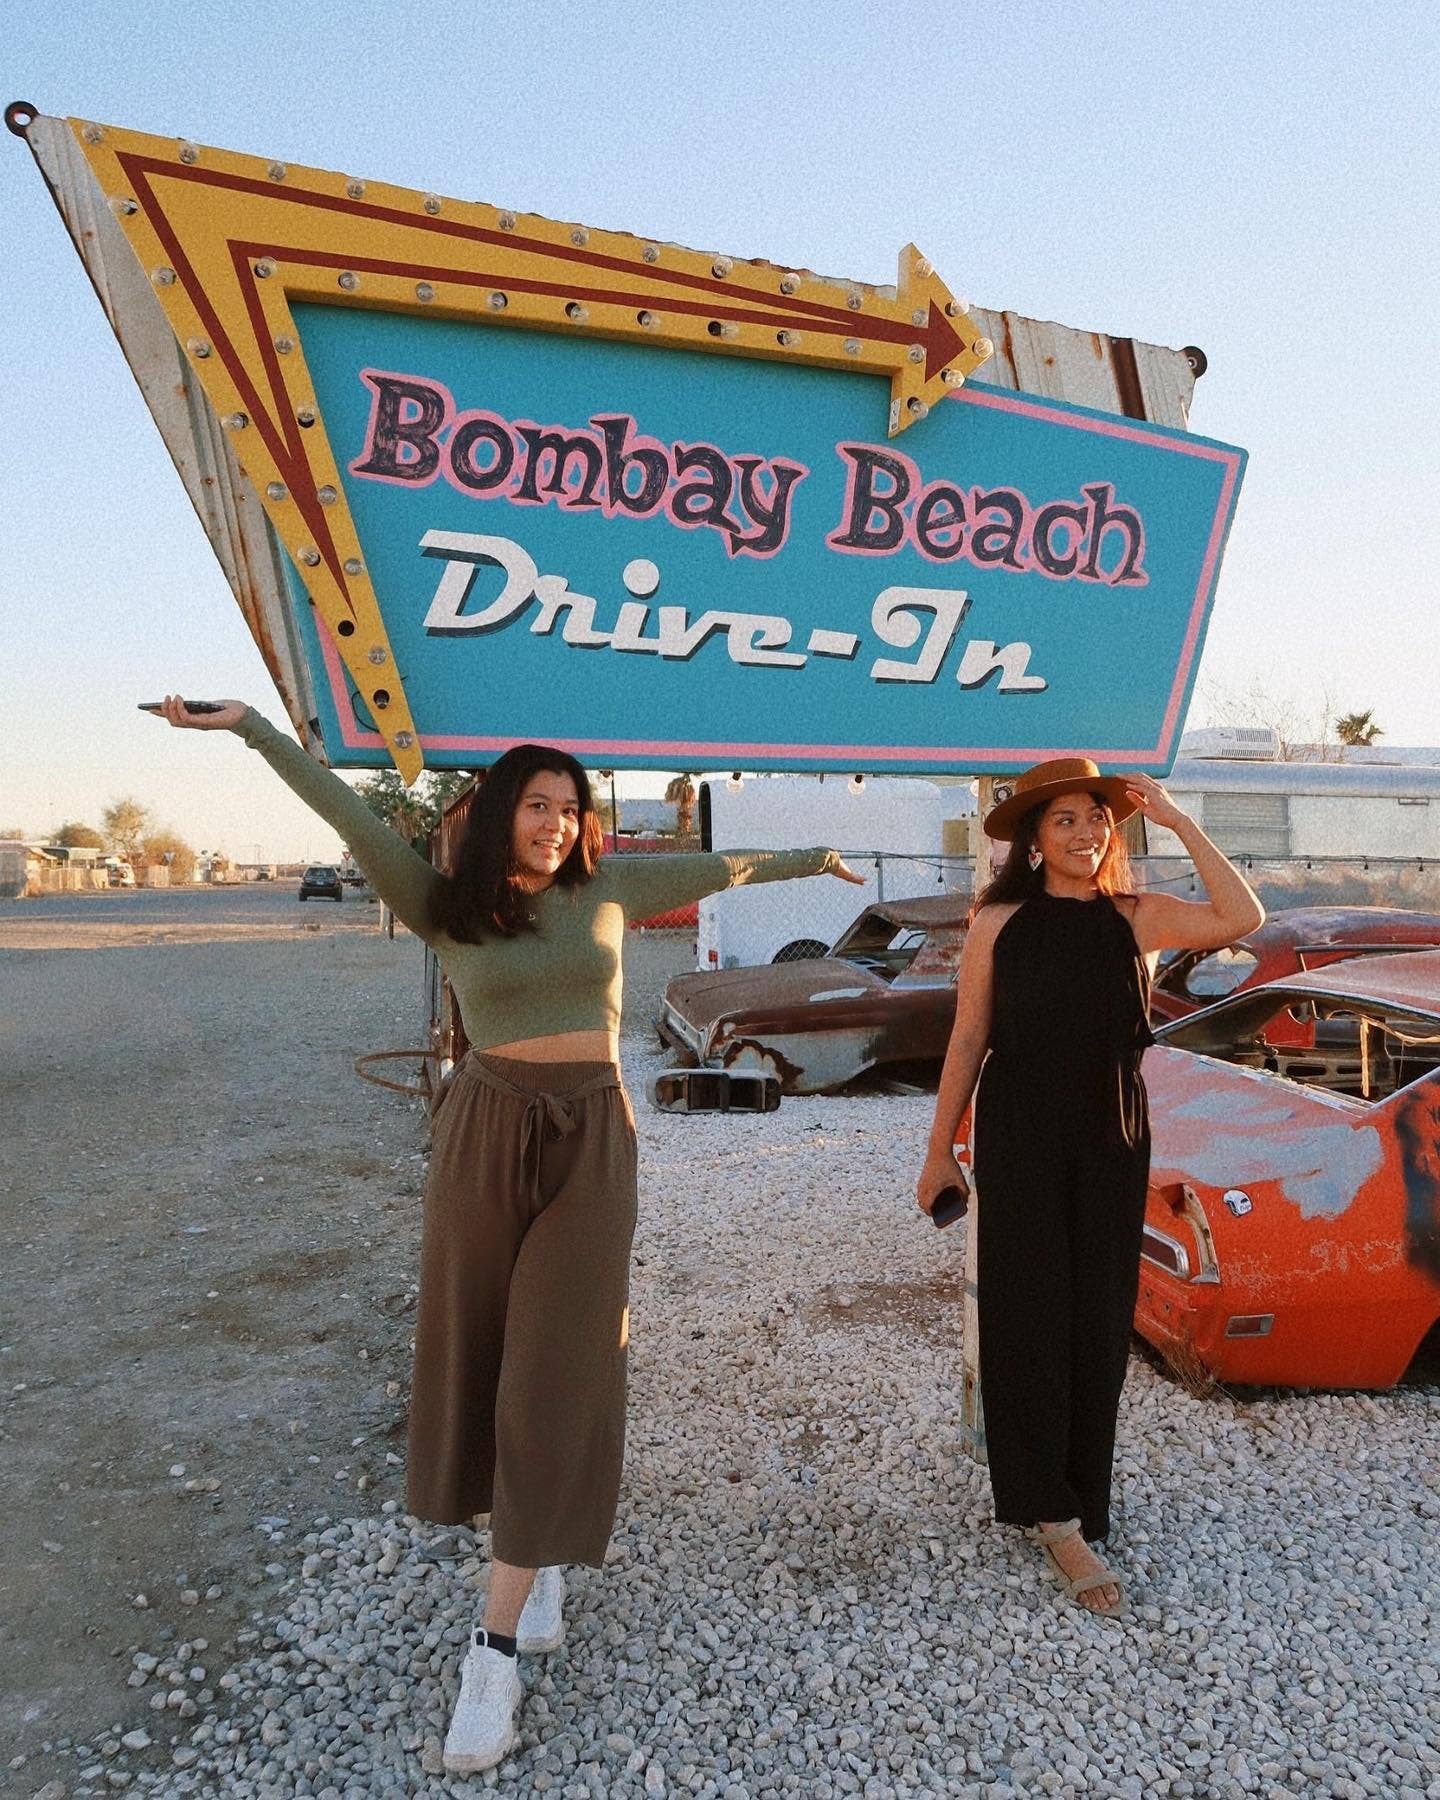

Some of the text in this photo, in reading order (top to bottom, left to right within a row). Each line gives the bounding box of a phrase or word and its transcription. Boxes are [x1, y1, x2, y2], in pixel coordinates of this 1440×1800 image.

[350, 370, 1147, 586] Bombay Beach
[418, 529, 1048, 693] Drive-In
